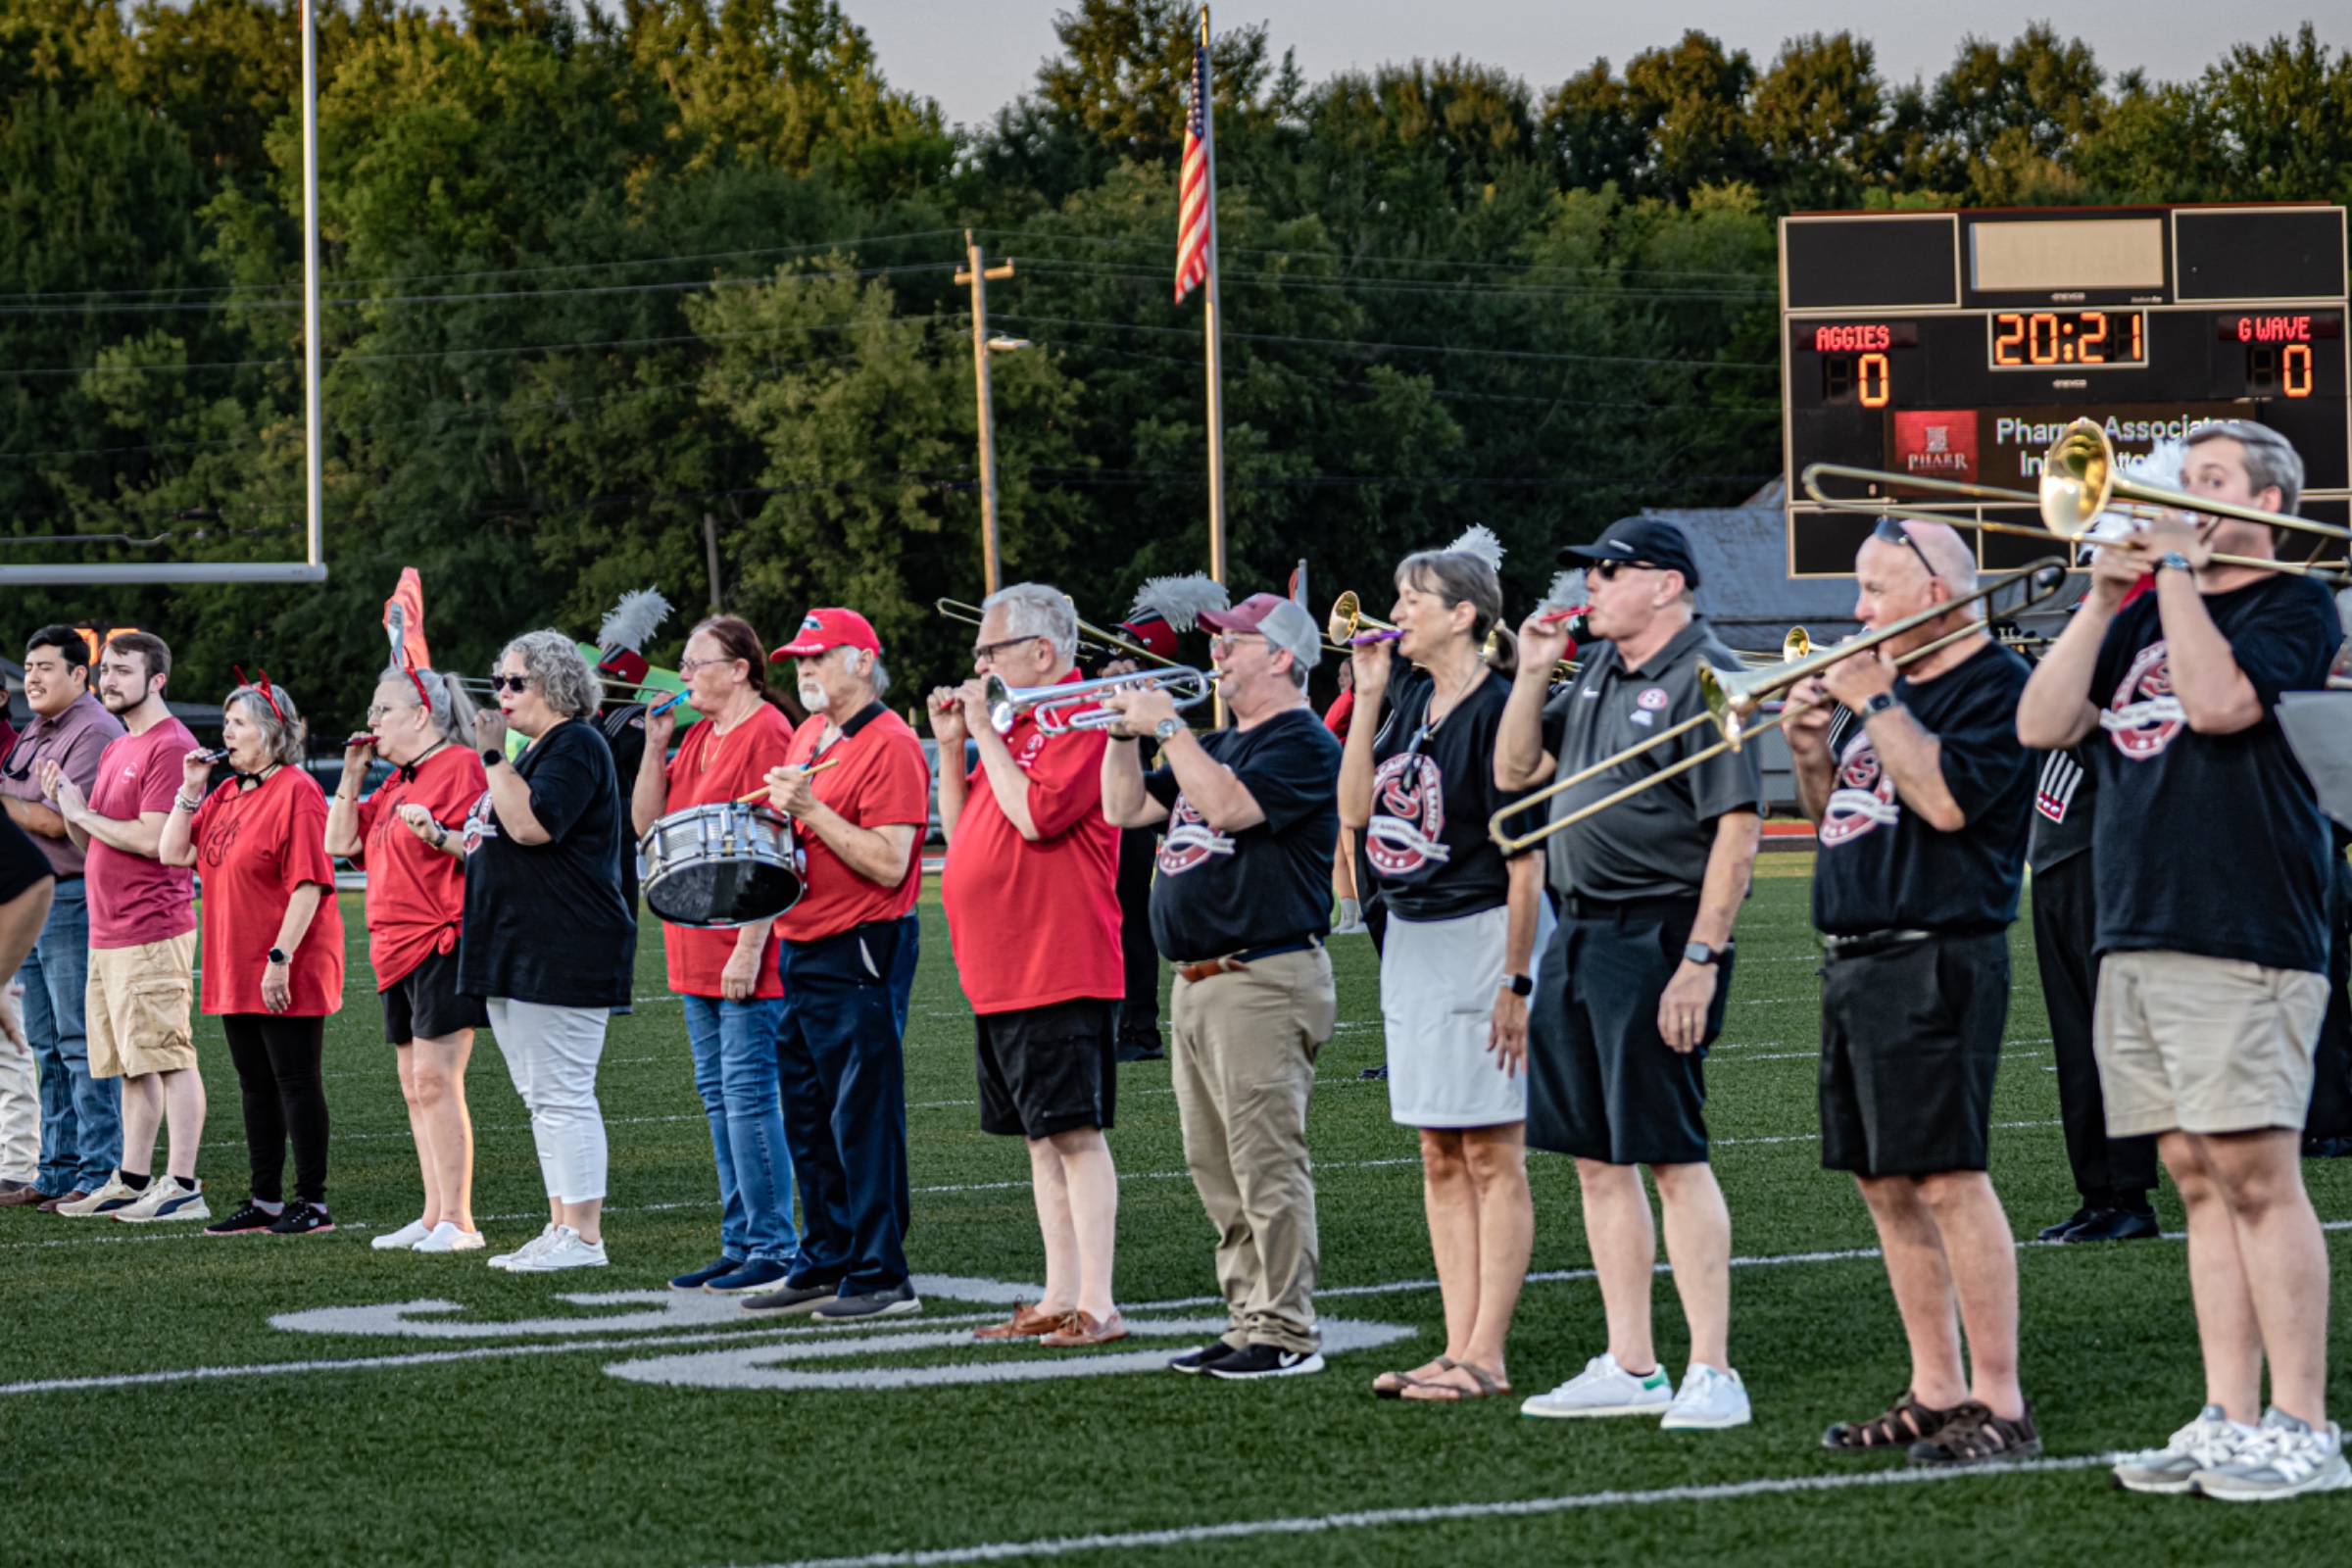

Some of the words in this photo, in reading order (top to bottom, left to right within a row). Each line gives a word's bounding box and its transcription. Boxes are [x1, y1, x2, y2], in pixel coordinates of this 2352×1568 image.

[1816, 325, 1890, 352] AGGIES
[1995, 312, 2141, 365] 20:21
[1858, 353, 1889, 408] 0
[2282, 344, 2312, 398] 0
[1996, 416, 2067, 445] Pharr
[2104, 414, 2240, 441] Associa
